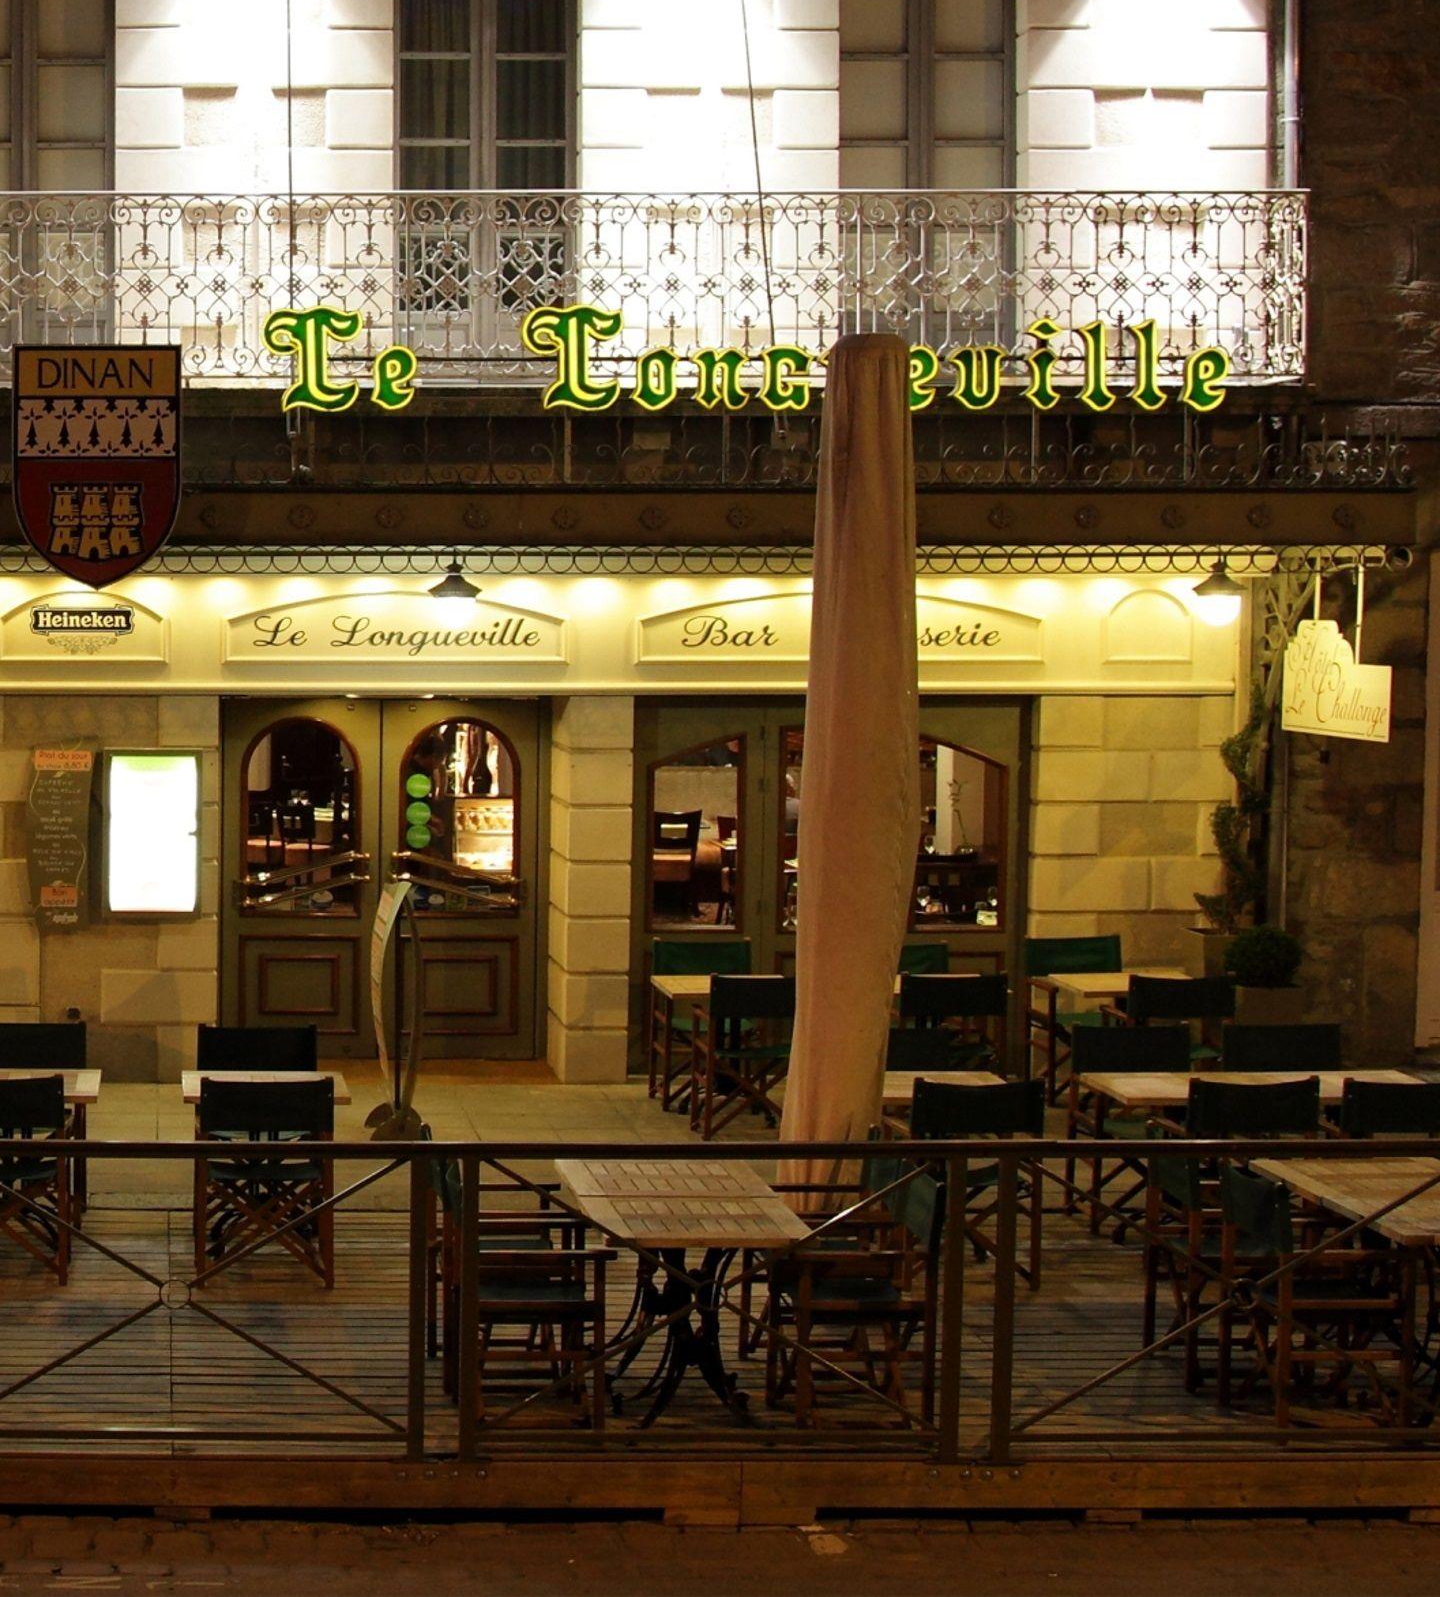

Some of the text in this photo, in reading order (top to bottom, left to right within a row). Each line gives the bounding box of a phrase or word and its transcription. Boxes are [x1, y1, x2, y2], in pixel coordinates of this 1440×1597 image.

[36, 357, 154, 390] DINAN
[262, 305, 1231, 412] Le Longeville
[37, 611, 127, 628] Heineken
[253, 615, 541, 657] Le Longueville
[681, 615, 780, 648] Bar
